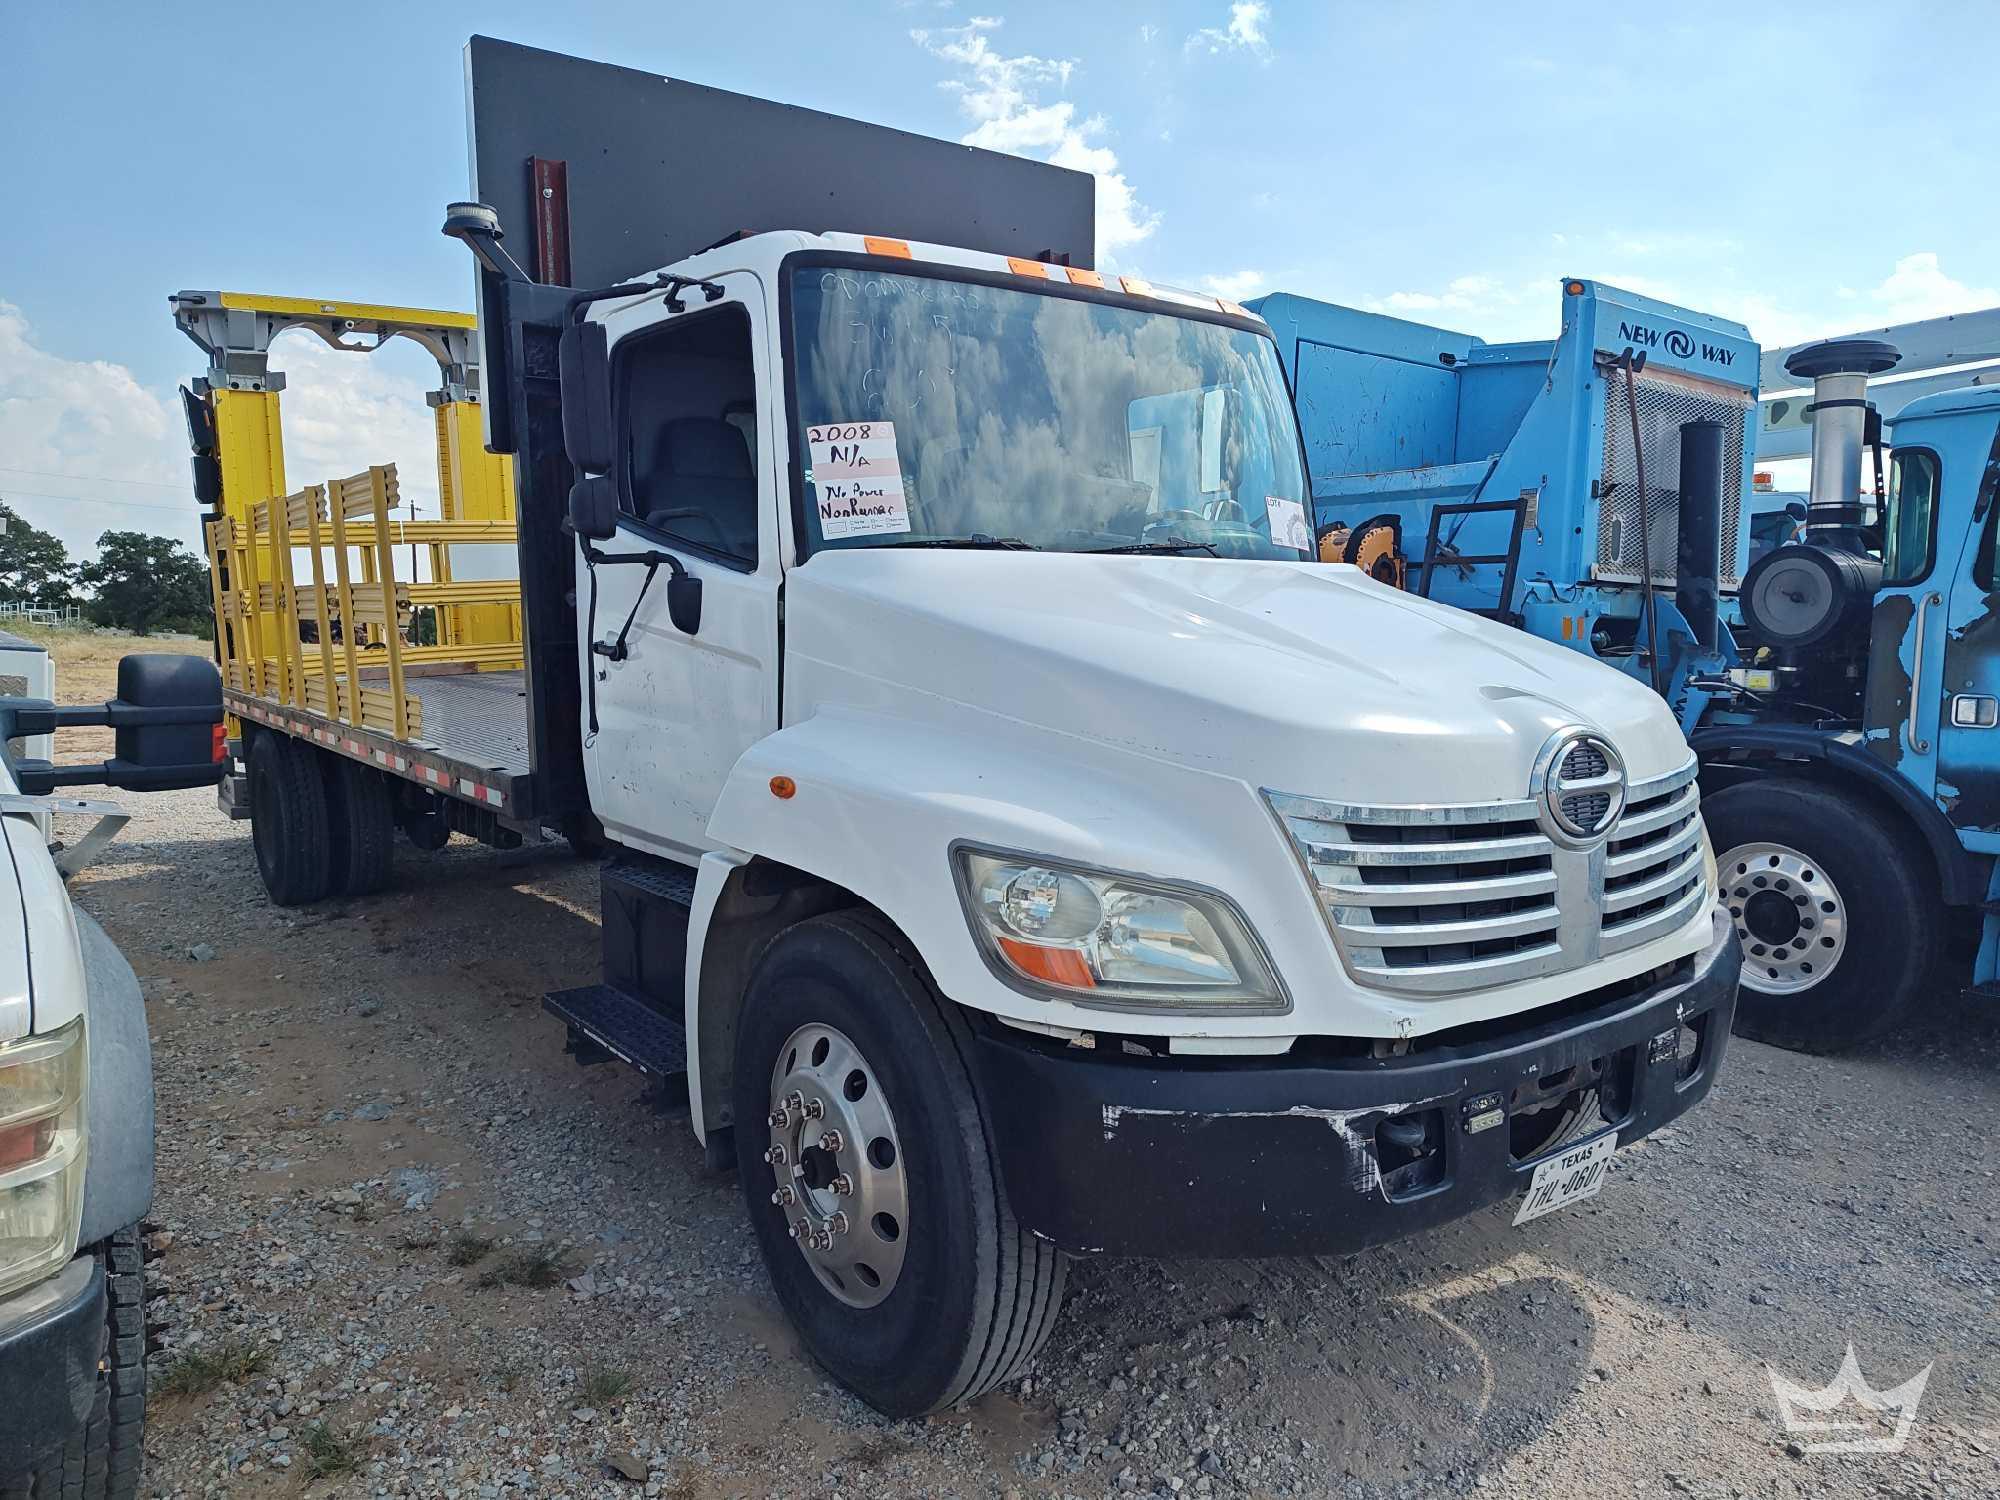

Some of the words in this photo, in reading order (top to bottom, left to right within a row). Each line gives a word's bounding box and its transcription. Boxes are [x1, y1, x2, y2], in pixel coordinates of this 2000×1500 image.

[1618, 321, 1661, 347] NEW
[1702, 343, 1736, 366] WAY
[810, 424, 872, 443] 2008
[830, 443, 872, 467] N/A
[825, 486, 847, 500] No
[1561, 1146, 1593, 1170] TEXAS
